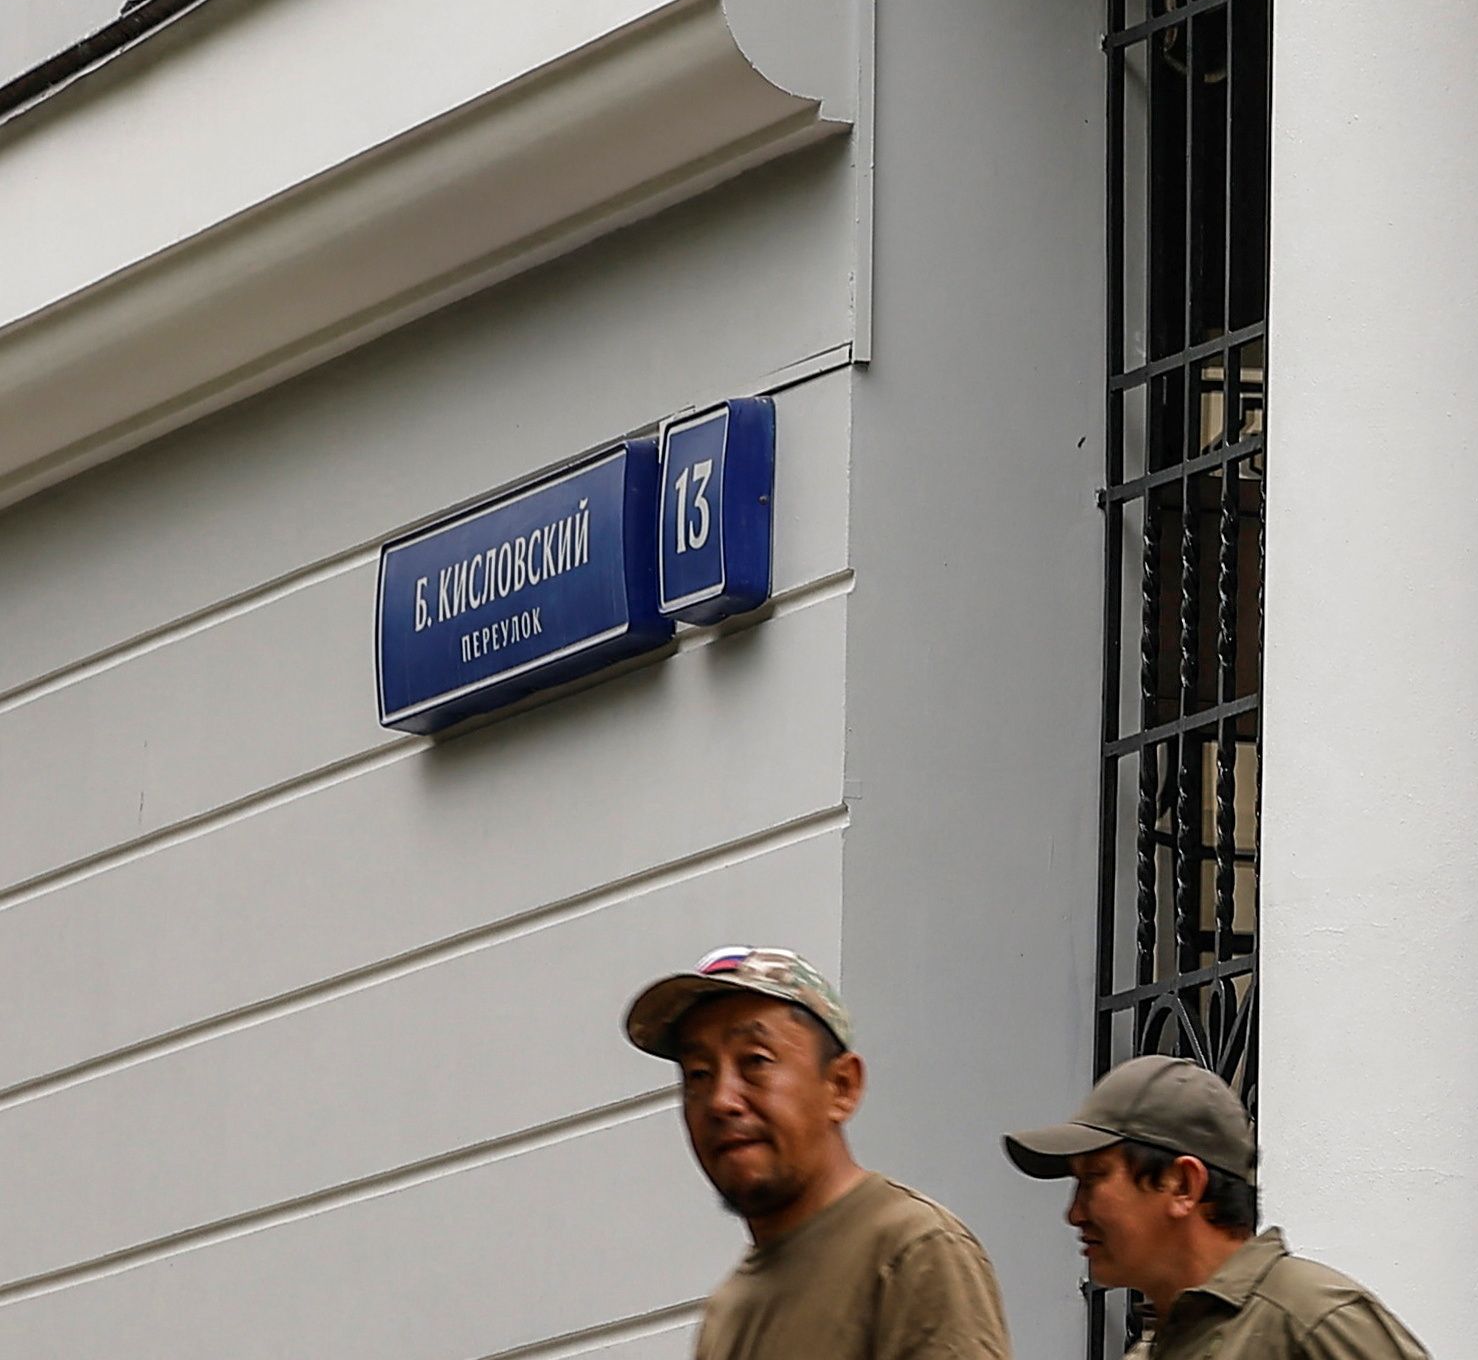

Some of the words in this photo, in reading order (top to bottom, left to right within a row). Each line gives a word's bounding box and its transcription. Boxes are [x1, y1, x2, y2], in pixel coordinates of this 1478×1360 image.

[674, 458, 714, 556] 13
[413, 575, 433, 633] Б.
[438, 497, 590, 623] КИСЛОВСКИЙ
[461, 606, 543, 663] ПЕРЕУЛОК
